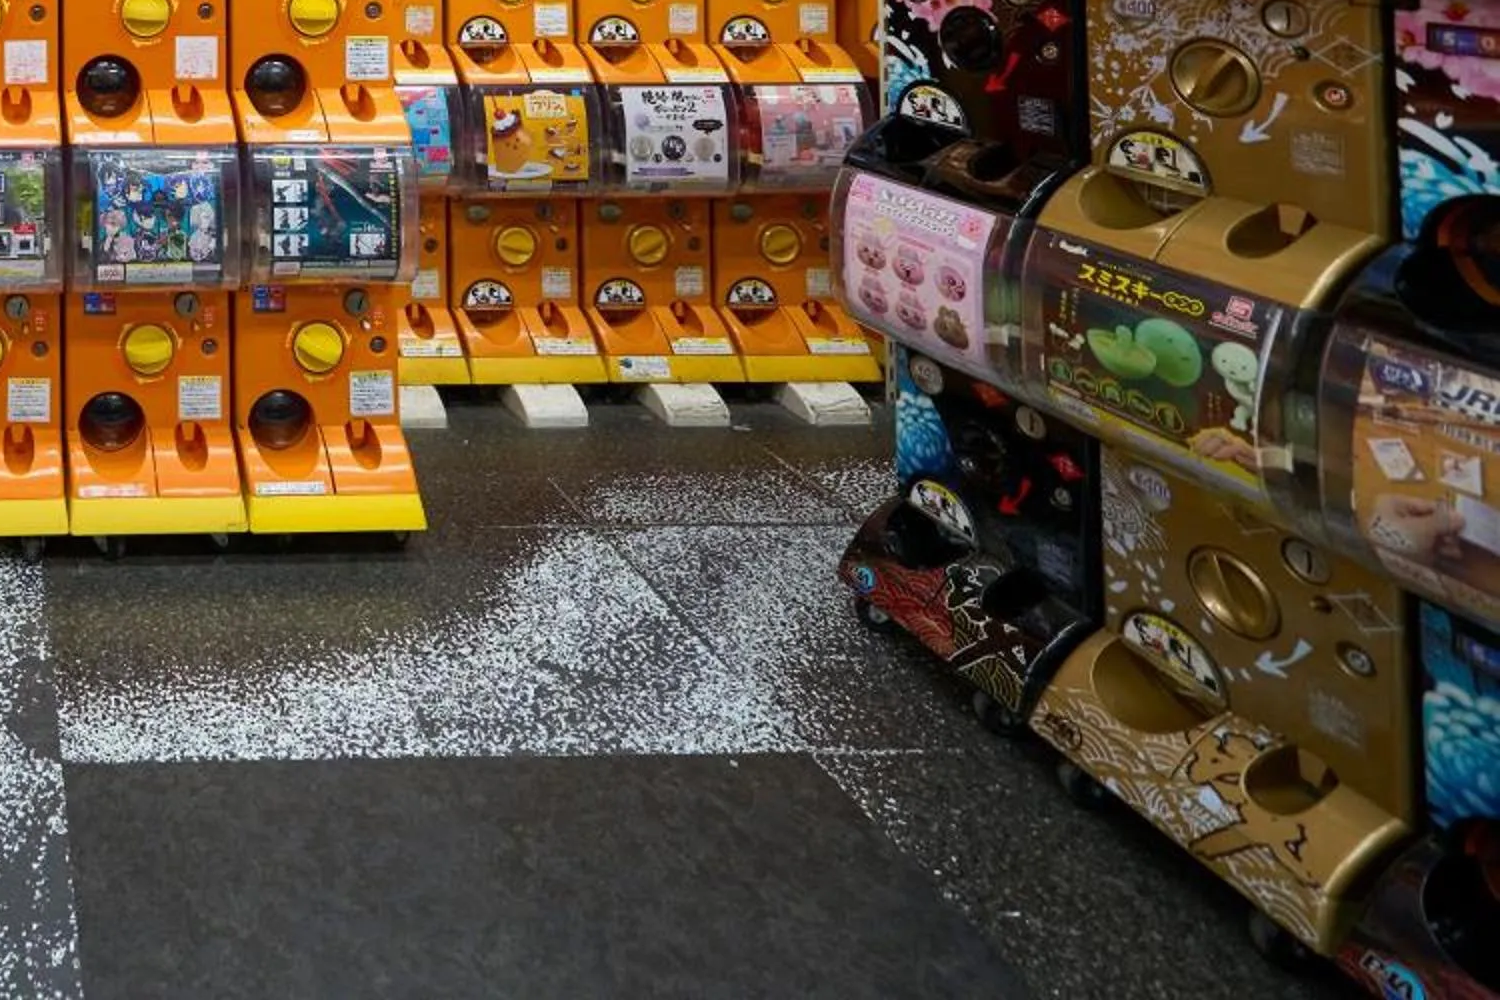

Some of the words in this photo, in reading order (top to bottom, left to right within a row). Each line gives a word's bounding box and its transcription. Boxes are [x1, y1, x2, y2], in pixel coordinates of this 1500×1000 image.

[1076, 262, 1163, 300] スミスキー
[1440, 384, 1500, 417] JR
